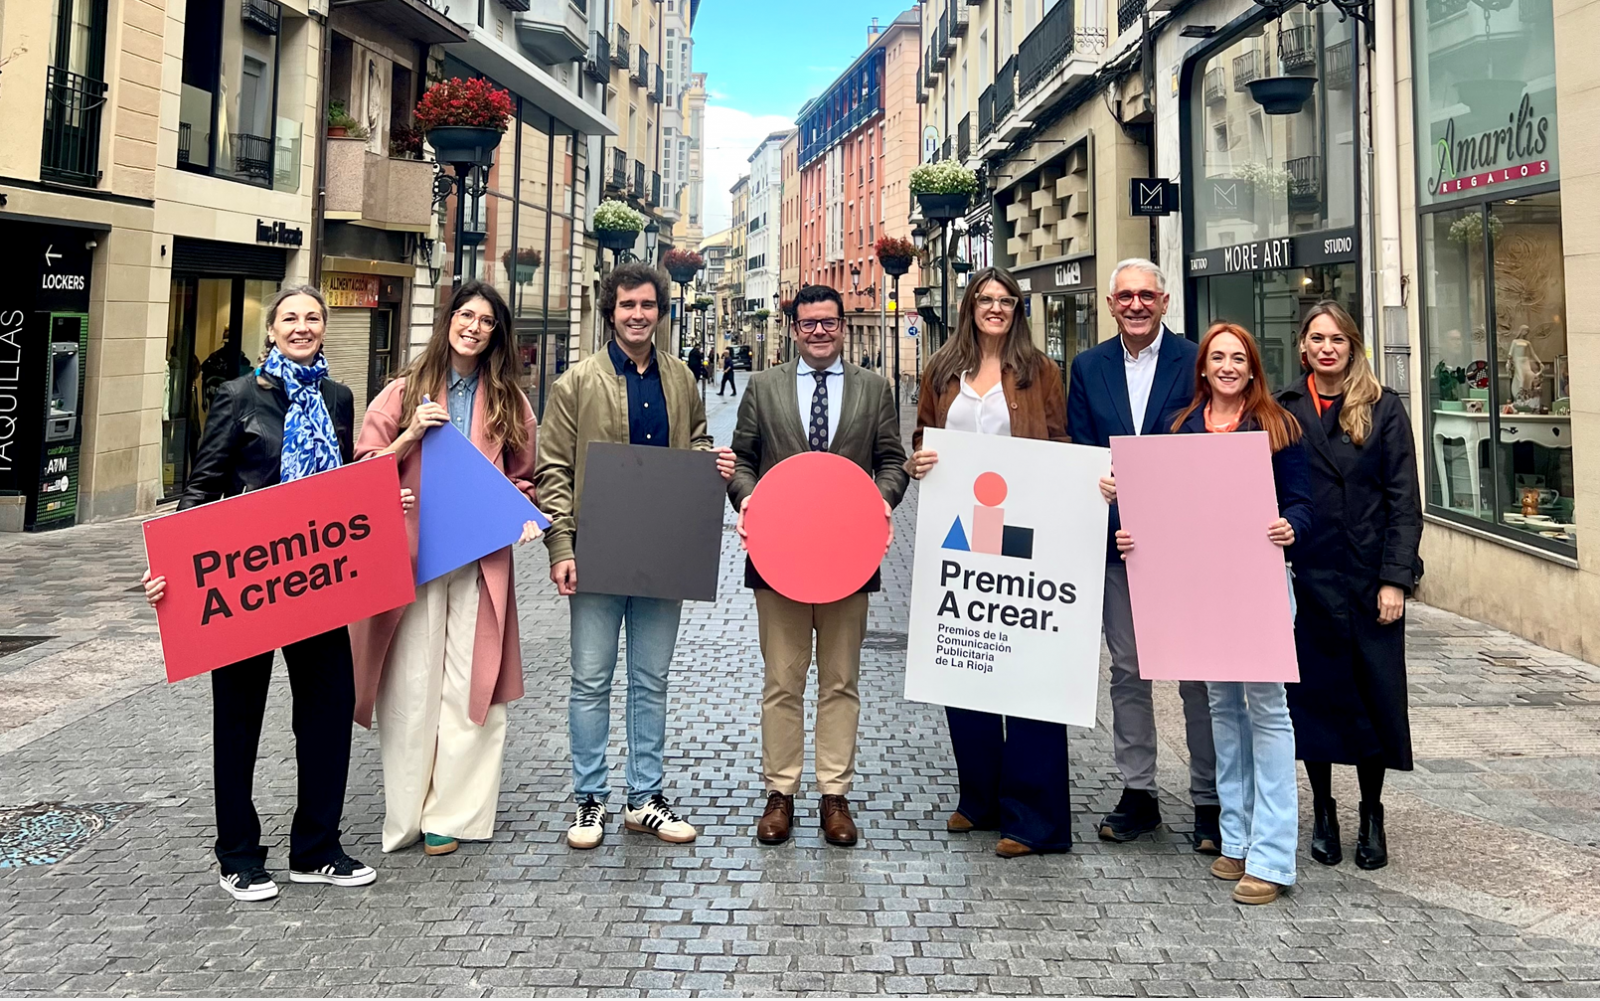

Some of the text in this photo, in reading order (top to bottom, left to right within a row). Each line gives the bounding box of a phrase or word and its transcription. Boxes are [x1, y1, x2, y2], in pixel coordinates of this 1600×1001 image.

[1428, 92, 1549, 196] Amarilis
[1442, 161, 1547, 193] REGALOS
[1224, 243, 1259, 272] MORE
[1263, 239, 1290, 268] ART
[1324, 236, 1353, 254] STUDIO
[42, 273, 85, 290] LOCKERS
[192, 514, 372, 589] Premios
[200, 555, 359, 626] A crear.
[940, 559, 1077, 605] Premios
[937, 590, 1059, 633] A crear.
[936, 634, 1012, 653] Comunicación
[937, 623, 1009, 642] Premios de la
[935, 656, 994, 674] de La Rioja
[936, 644, 995, 662] Publicitaria
